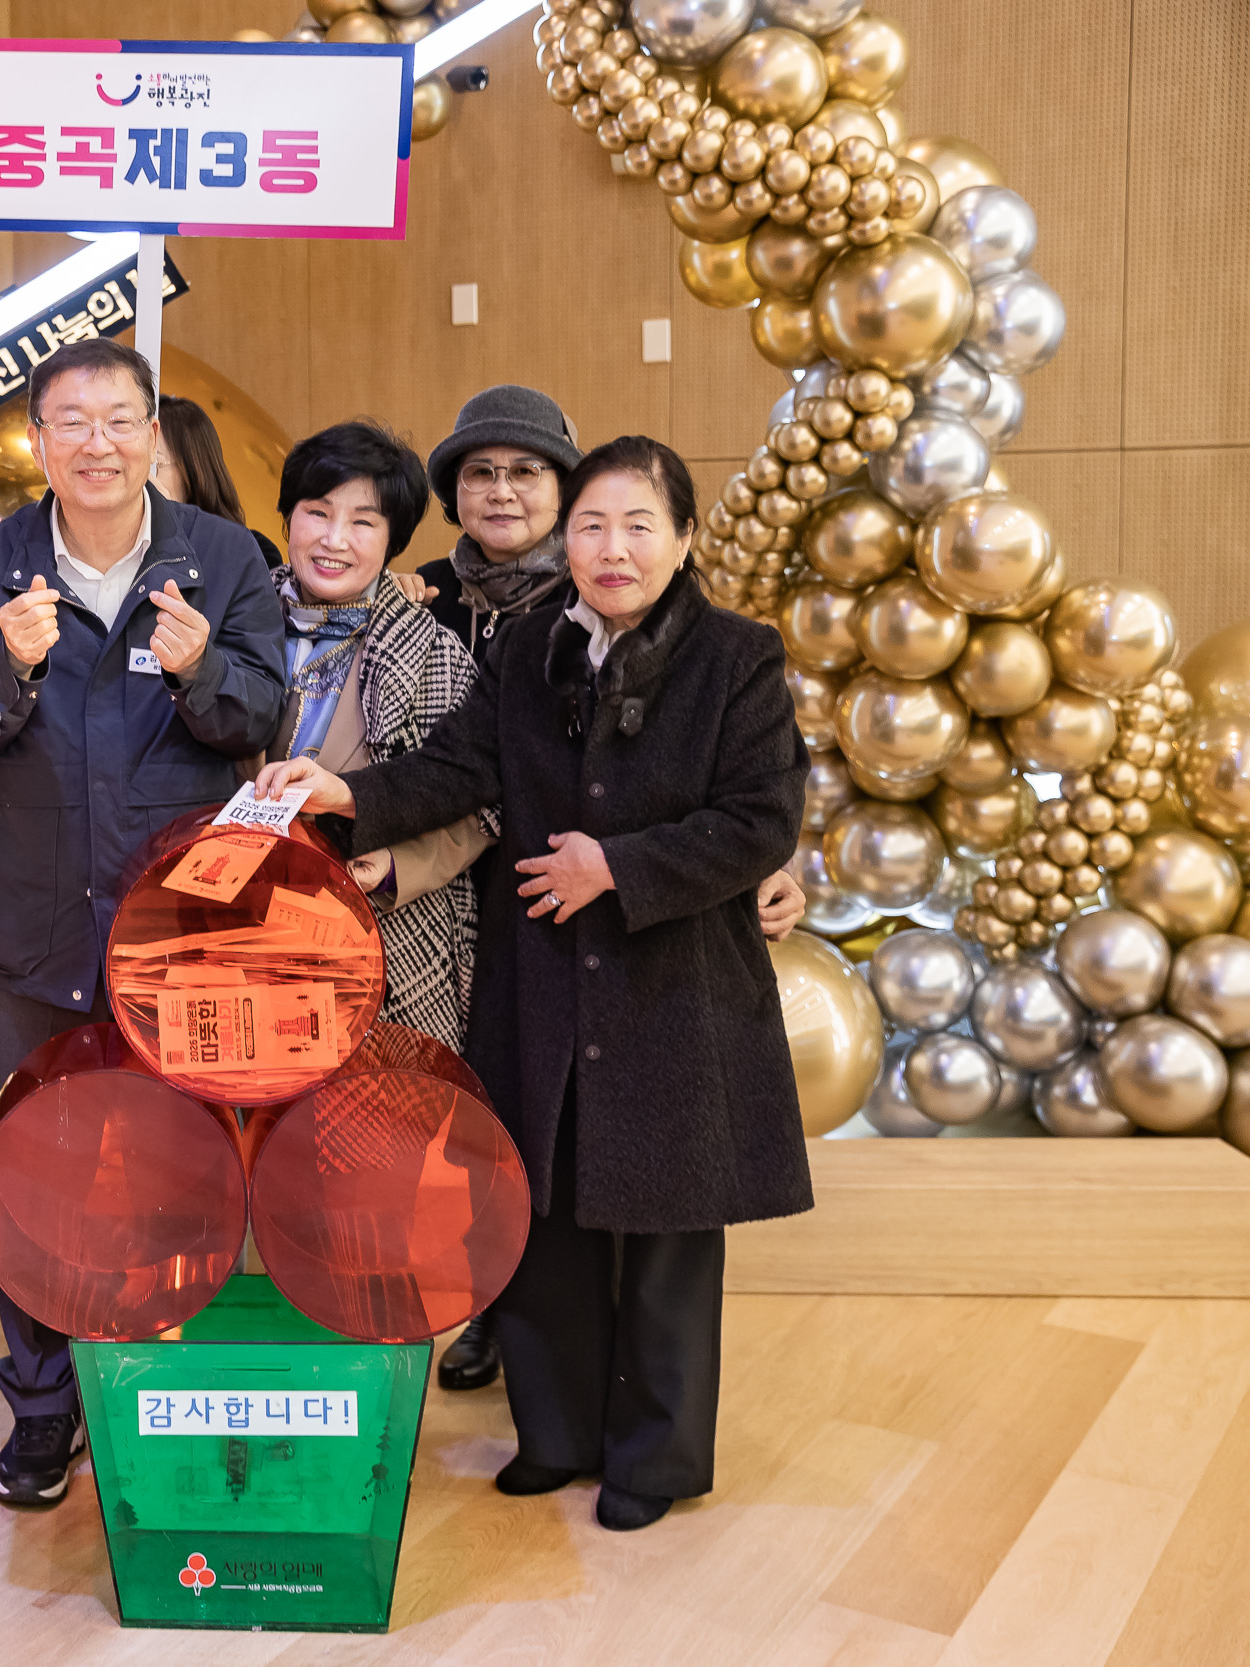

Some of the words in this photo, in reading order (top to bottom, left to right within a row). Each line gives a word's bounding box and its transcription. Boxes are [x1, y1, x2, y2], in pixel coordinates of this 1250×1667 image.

[147, 85, 210, 108] 행복광진
[17, 279, 135, 367] 나눔의
[189, 1039, 199, 1063] 2026
[198, 998, 219, 1063] 따뜻한
[218, 999, 234, 1062] 겨울나기
[144, 1396, 349, 1428] 감사합니다!
